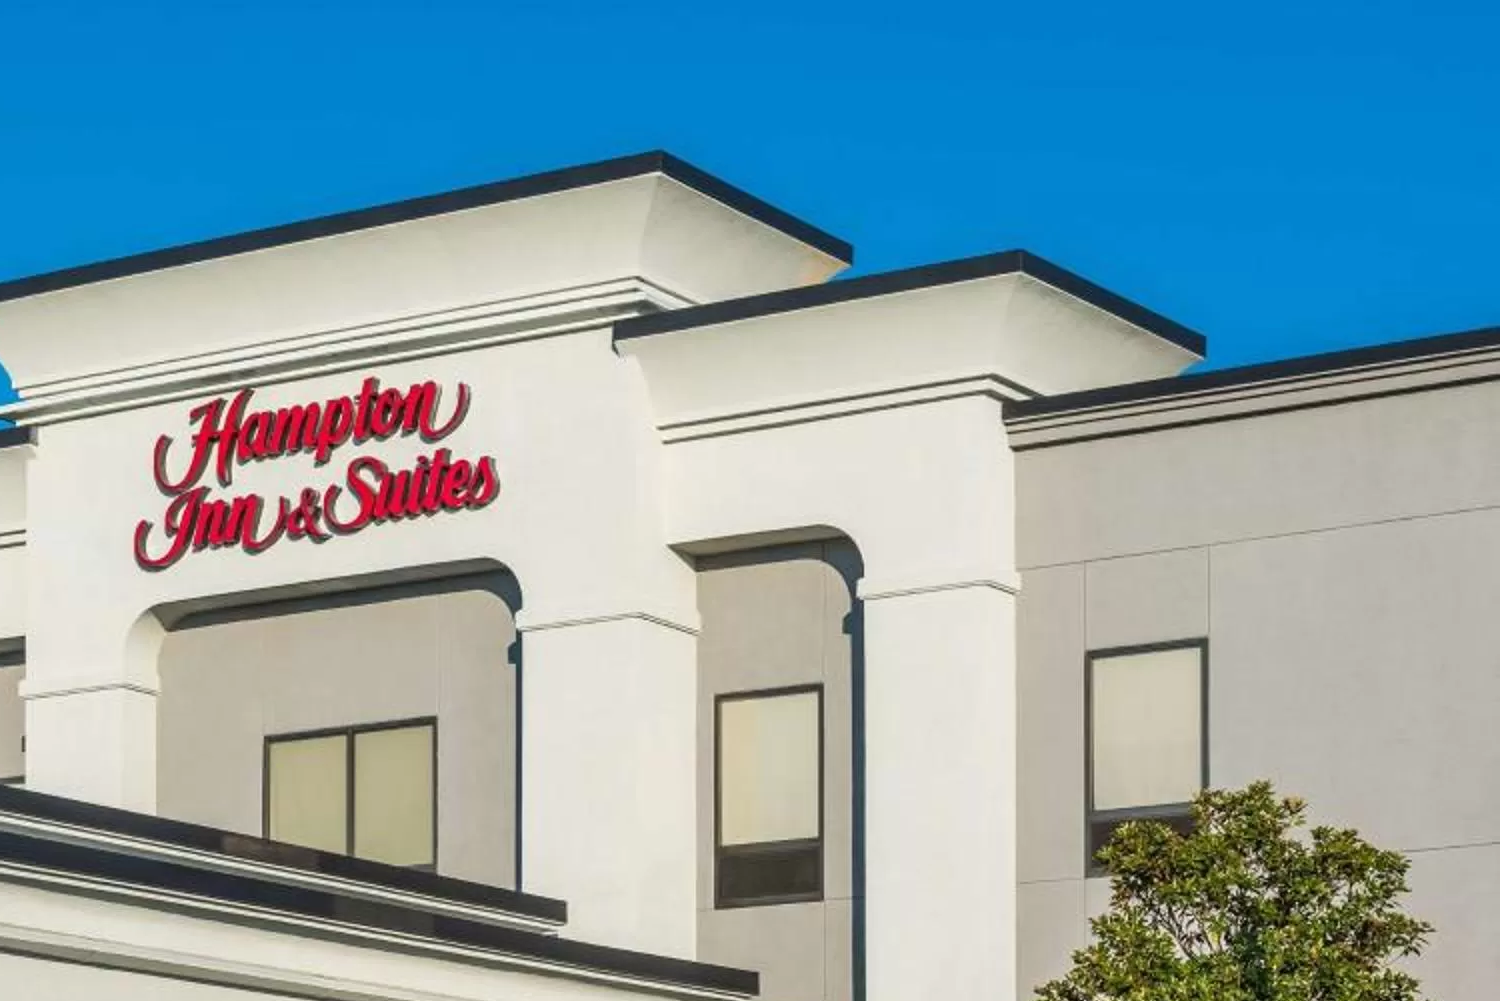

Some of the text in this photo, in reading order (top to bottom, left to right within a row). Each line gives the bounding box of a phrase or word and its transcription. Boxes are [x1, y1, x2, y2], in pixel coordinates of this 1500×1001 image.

[154, 376, 470, 497] Hampton
[134, 447, 500, 571] Inn & Suites
